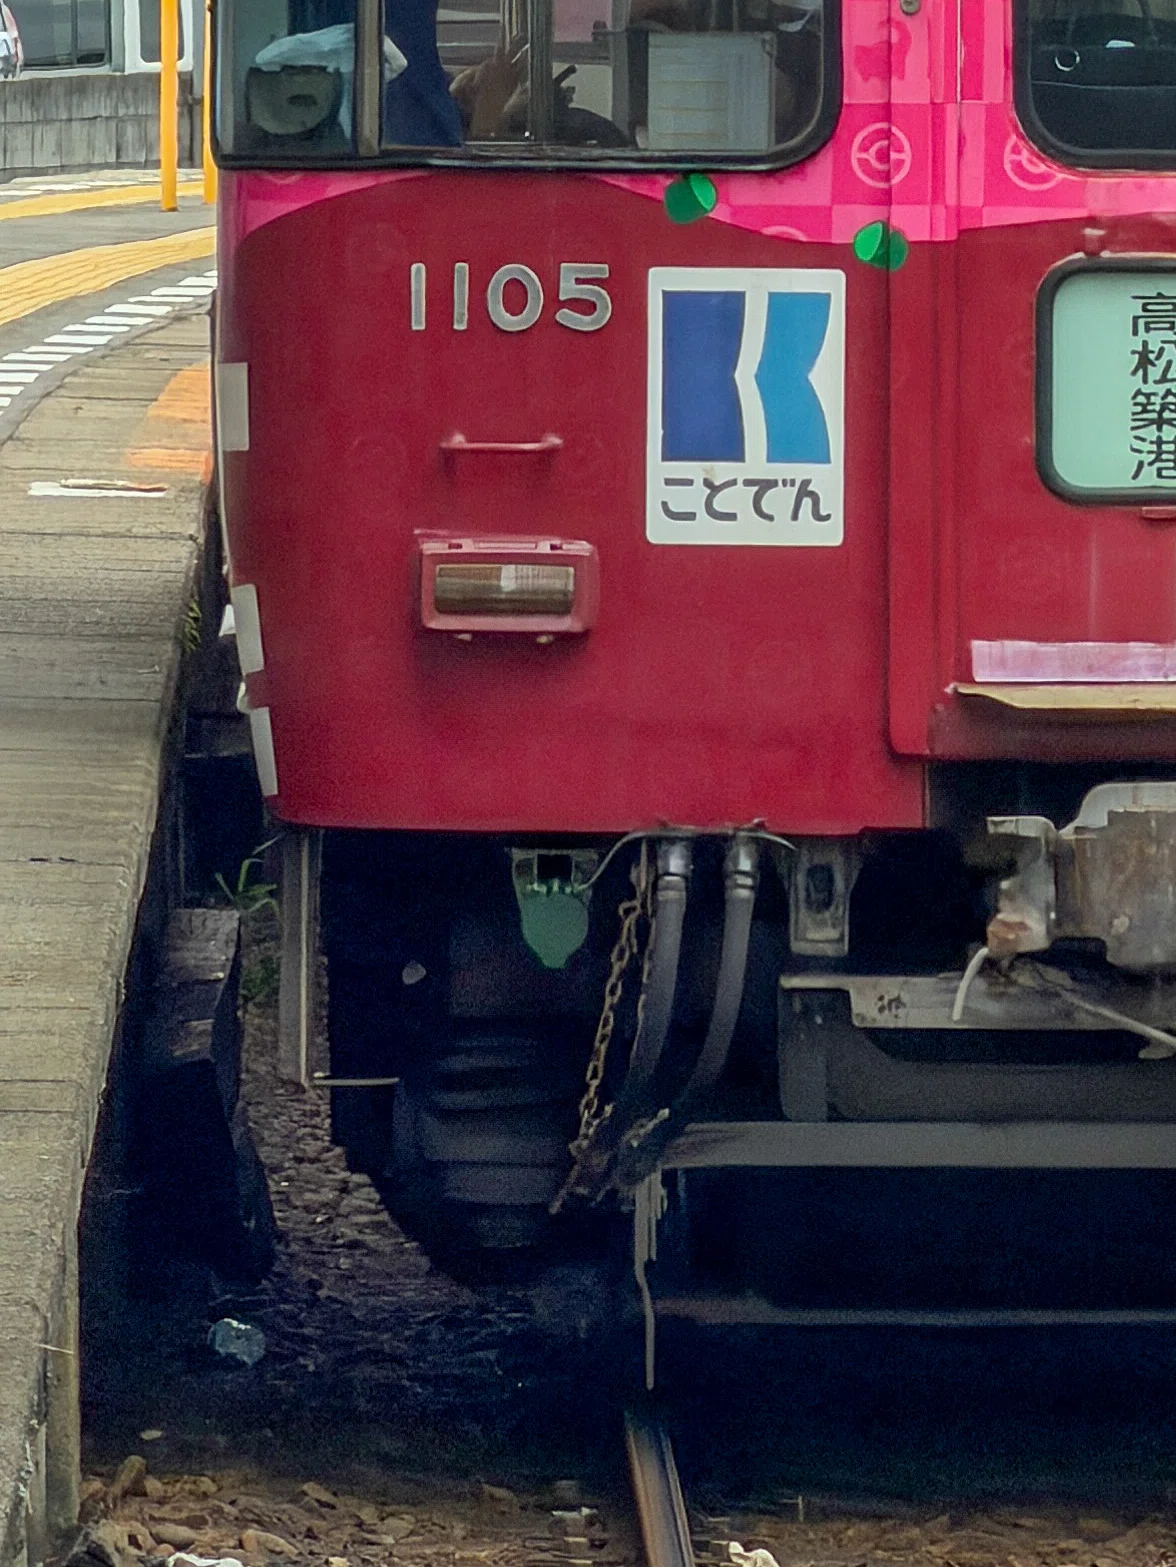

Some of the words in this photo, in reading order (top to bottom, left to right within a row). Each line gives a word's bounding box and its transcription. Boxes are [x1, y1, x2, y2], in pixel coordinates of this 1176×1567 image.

[410, 262, 612, 332] 1105
[660, 477, 832, 522] ことでん
